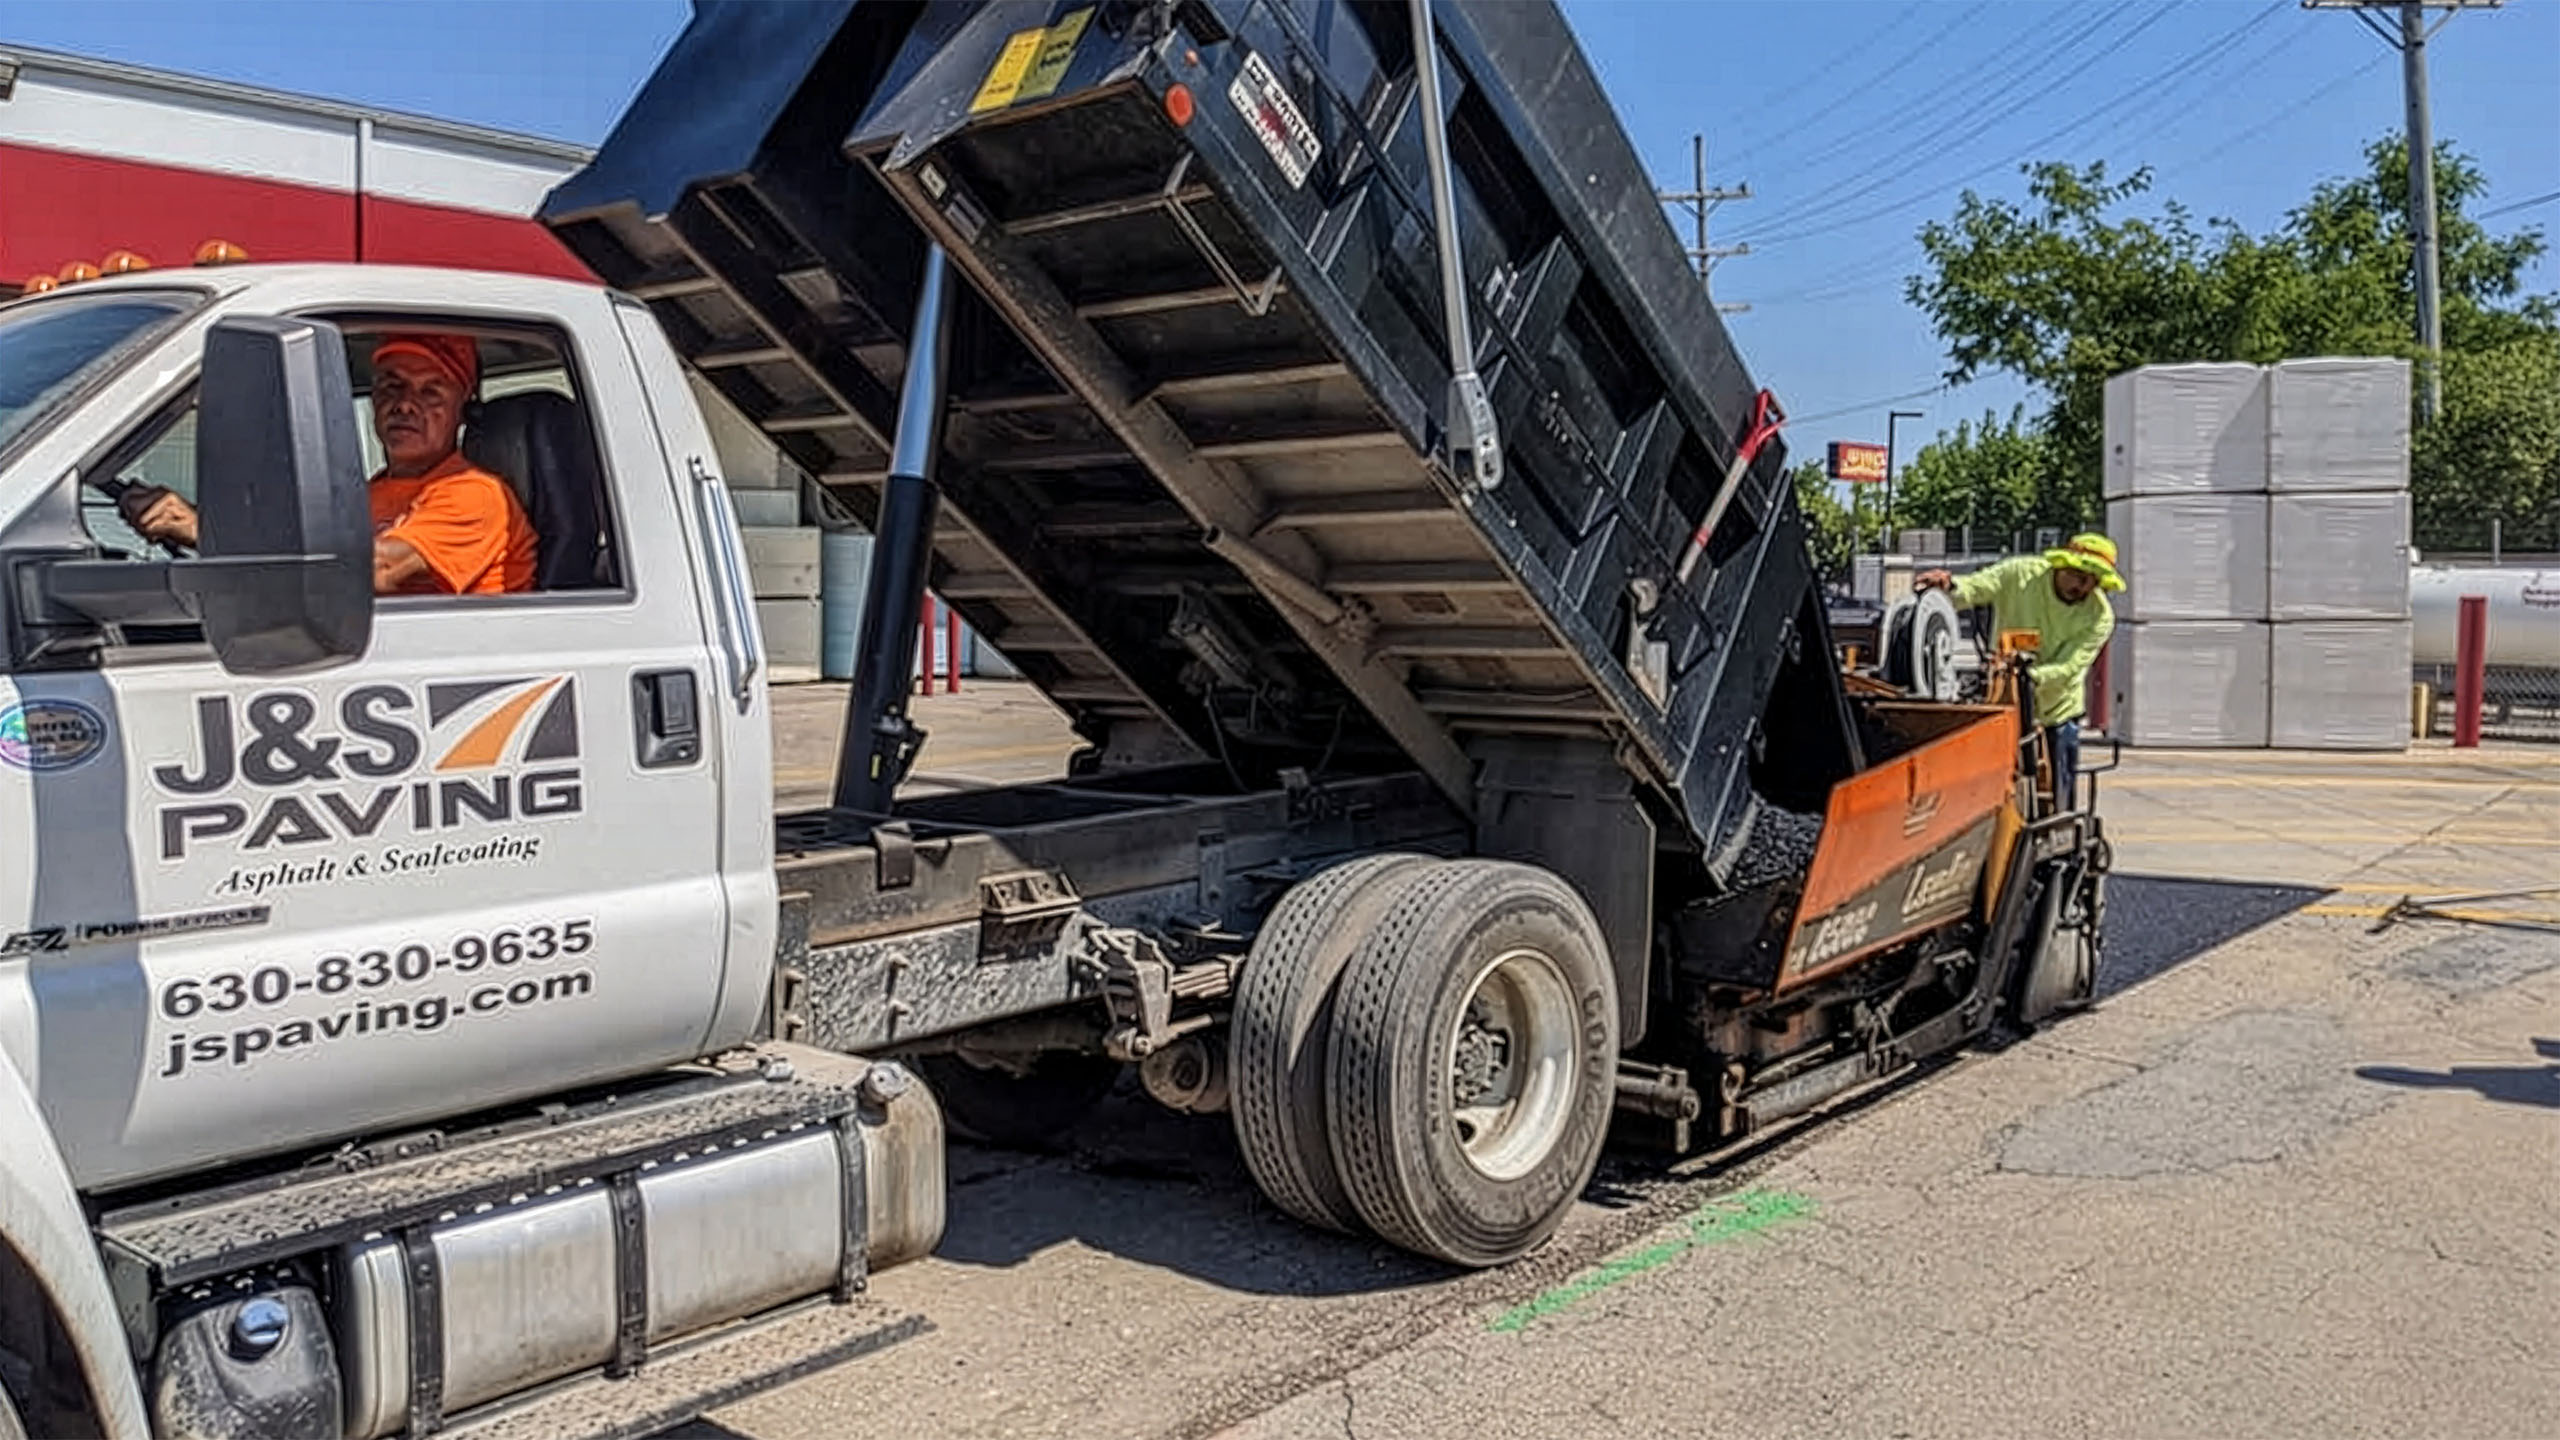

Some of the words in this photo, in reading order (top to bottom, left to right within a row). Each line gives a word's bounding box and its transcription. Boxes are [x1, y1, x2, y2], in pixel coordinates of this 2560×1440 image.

[154, 685, 419, 793] J&S
[161, 769, 582, 859] PAVING
[215, 858, 336, 895] Asphalt
[346, 853, 367, 877] &
[162, 919, 593, 1018] 630-830-9635
[162, 971, 591, 1077] jspaving.com
